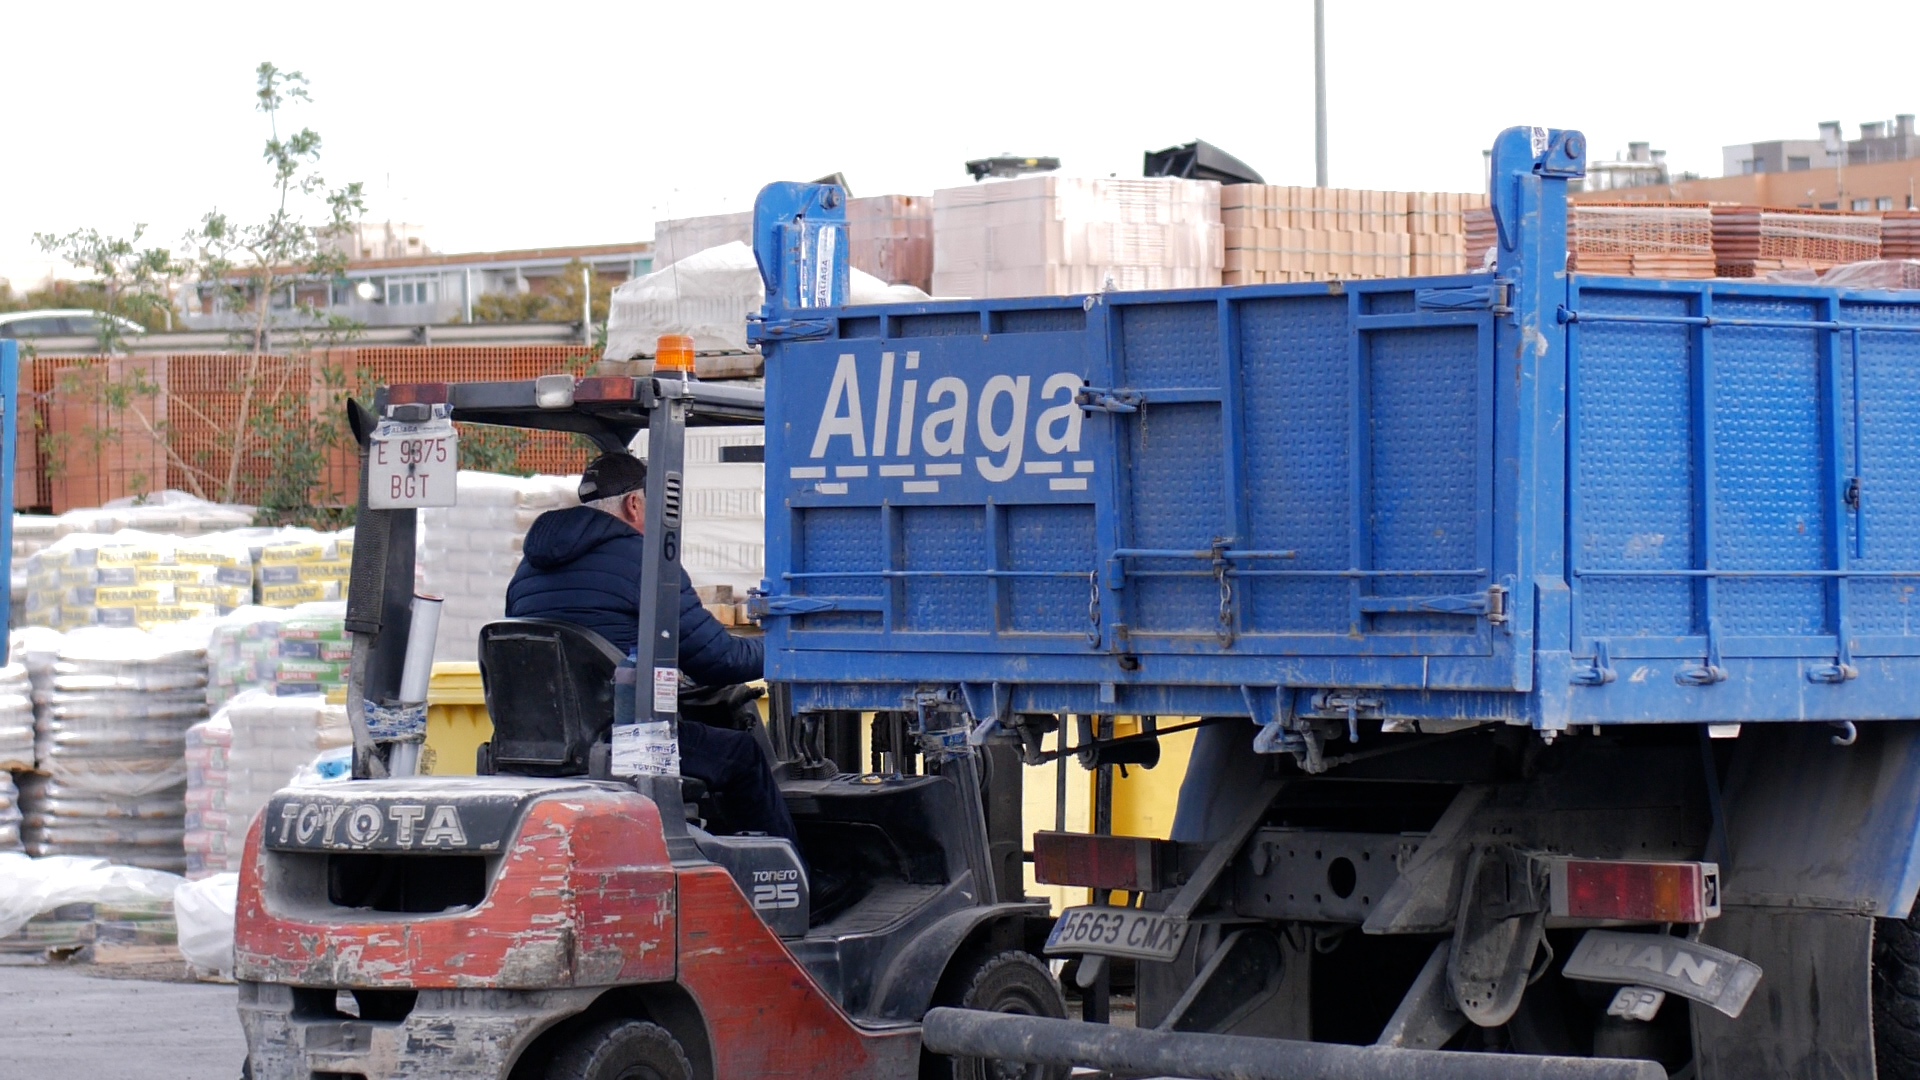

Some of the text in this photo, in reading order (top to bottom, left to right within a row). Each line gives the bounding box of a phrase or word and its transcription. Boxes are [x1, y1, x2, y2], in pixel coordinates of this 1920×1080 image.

[809, 350, 1085, 482] Aliaga
[377, 438, 447, 465] E 9375
[390, 473, 429, 499] BGT
[663, 531, 677, 562] 6
[279, 803, 468, 847] TOYOTA
[753, 869, 798, 882] TONERO
[754, 883, 800, 910] 25
[1062, 912, 1180, 951] 5663 CMX
[1600, 943, 1718, 987] MAN
